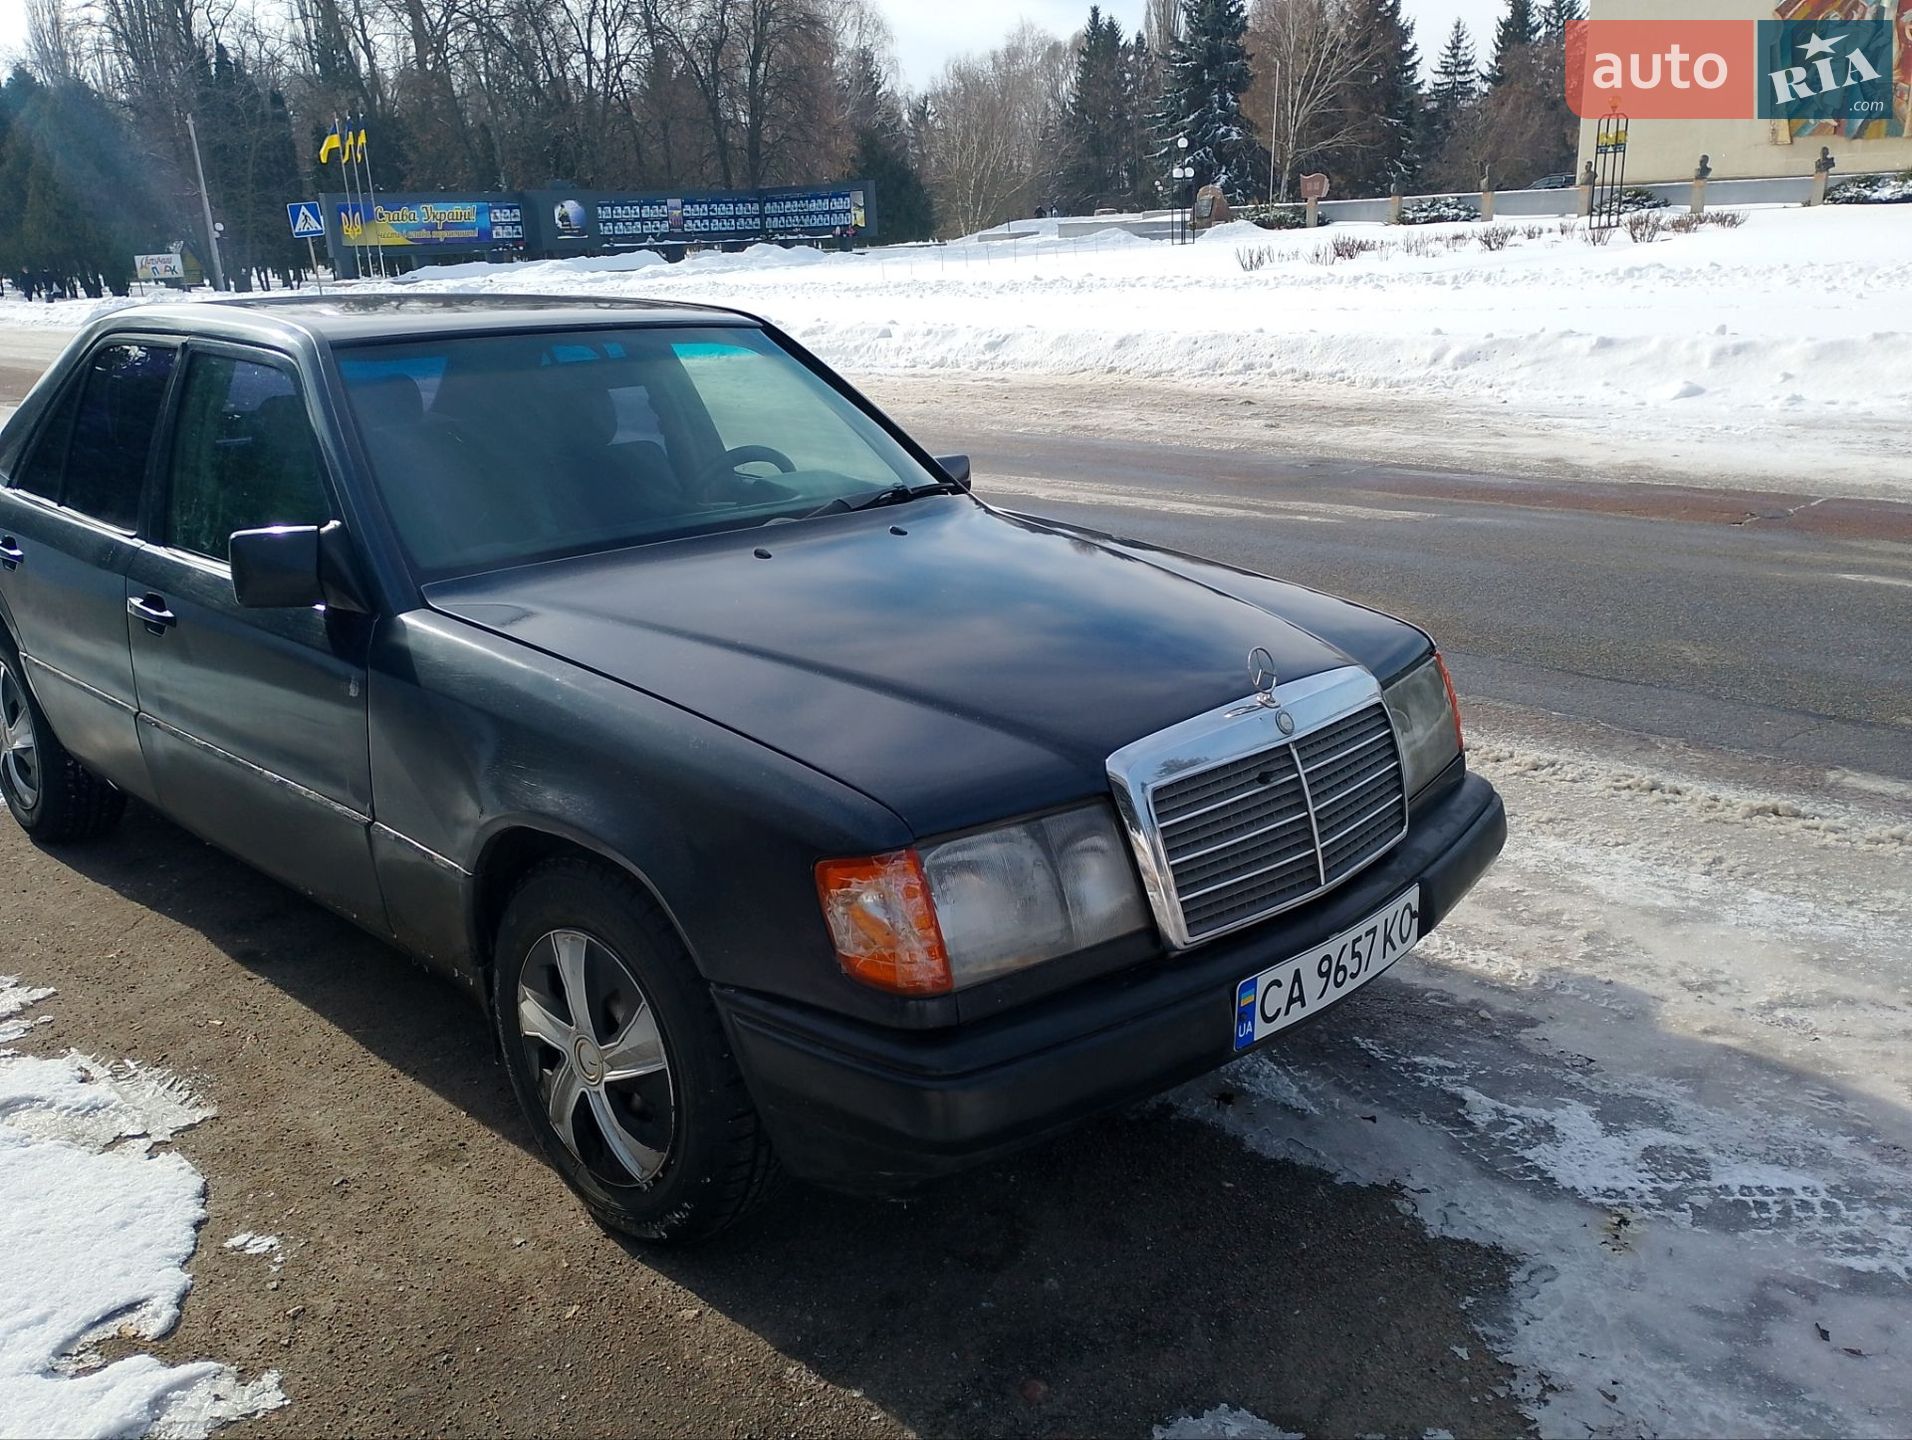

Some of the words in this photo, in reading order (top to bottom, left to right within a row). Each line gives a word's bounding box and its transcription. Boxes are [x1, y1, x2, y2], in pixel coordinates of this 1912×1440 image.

[375, 205, 418, 223] Слава
[420, 204, 478, 230] Україні!
[1259, 967, 1307, 1024] CA
[1316, 925, 1378, 1000] 9657
[1382, 902, 1413, 960] KO
[1238, 1020, 1253, 1038] UA
